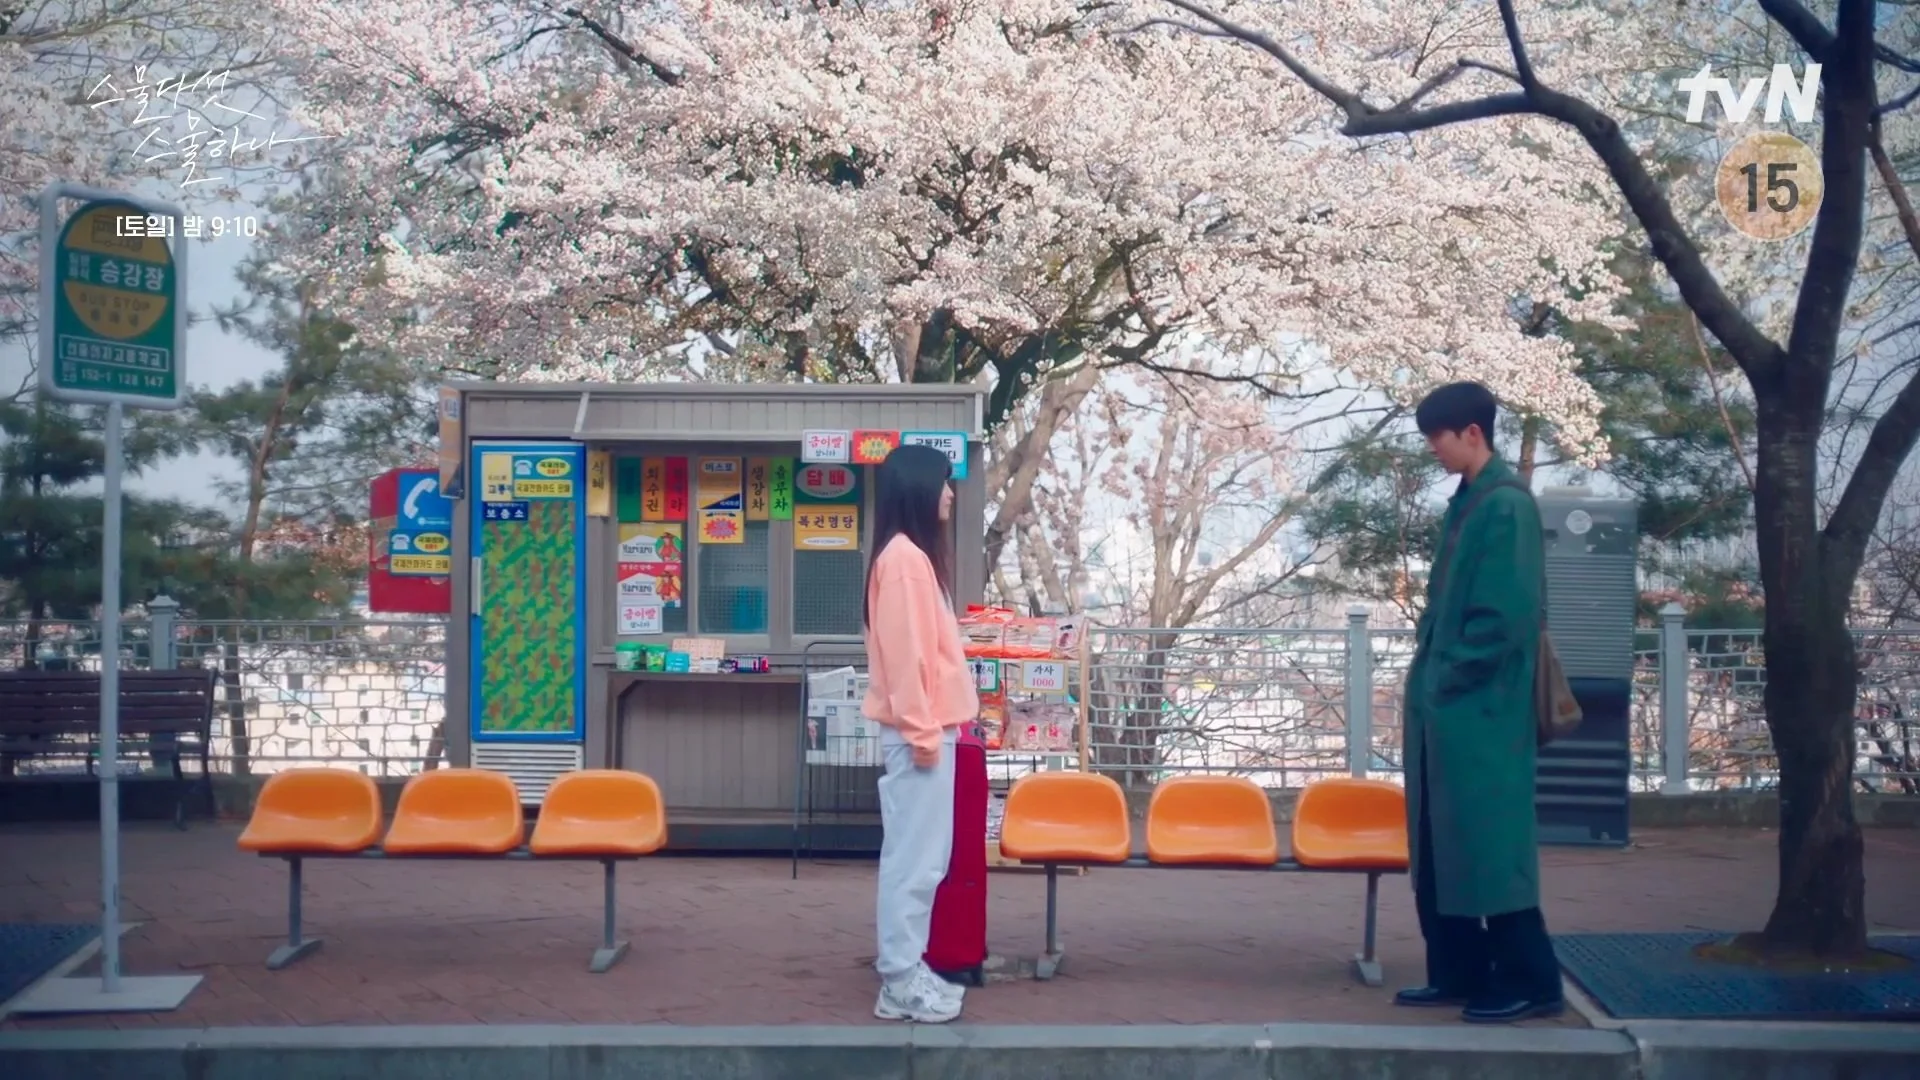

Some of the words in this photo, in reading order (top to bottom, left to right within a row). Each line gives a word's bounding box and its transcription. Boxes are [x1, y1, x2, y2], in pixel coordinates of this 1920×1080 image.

[99, 259, 165, 291] 승강장
[113, 296, 151, 312] STOP
[808, 435, 844, 449] 금이빨
[806, 469, 845, 486] 담배
[516, 483, 555, 493] 국제전화카드
[751, 465, 766, 513] 생강차
[773, 465, 789, 513] 율무차
[486, 508, 525, 520] 보충소
[797, 515, 854, 529] 복권명당
[393, 558, 433, 569] 국제전화카드
[623, 607, 657, 620] 금이빨
[1032, 677, 1055, 687] 1000
